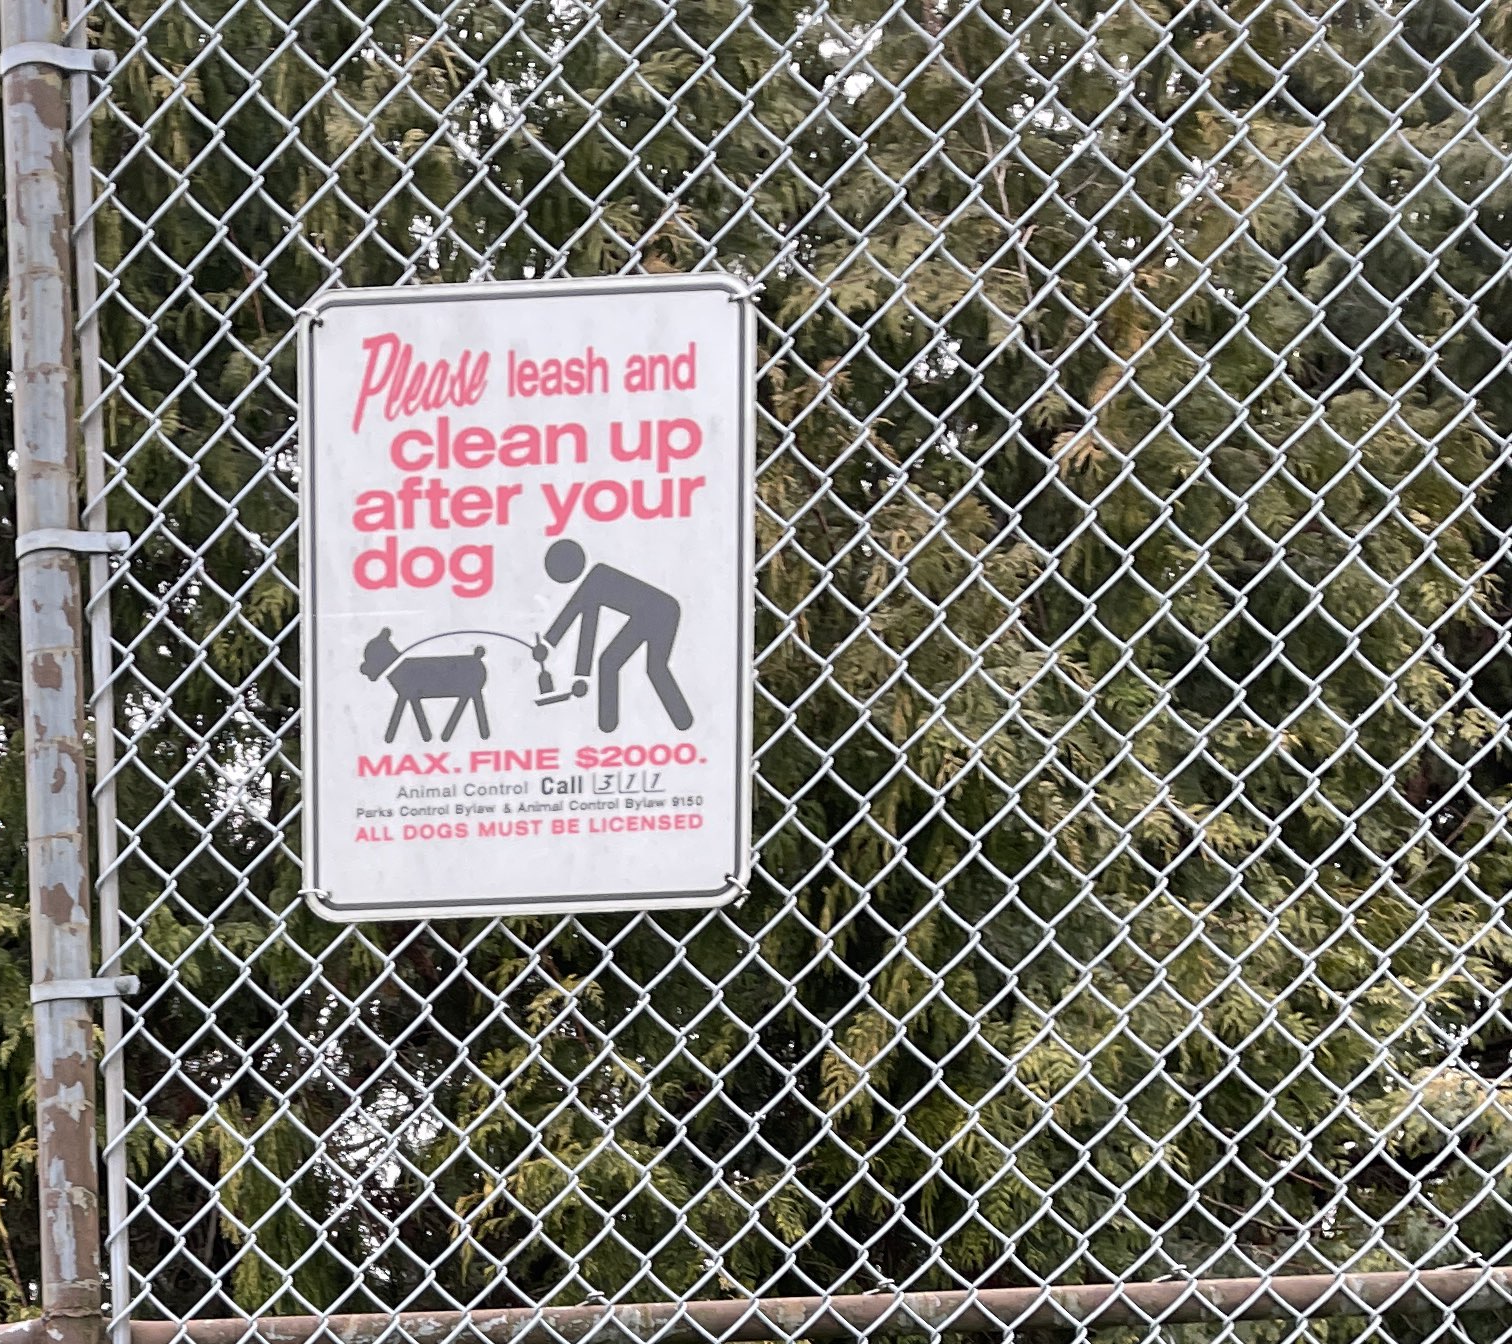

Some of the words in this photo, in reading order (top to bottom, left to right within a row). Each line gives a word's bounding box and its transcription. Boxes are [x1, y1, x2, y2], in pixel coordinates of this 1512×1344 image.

[352, 332, 490, 433] Please
[508, 347, 608, 397] leash
[625, 342, 696, 391] and
[390, 416, 587, 471] clean
[611, 418, 703, 473] up
[352, 477, 522, 532] after
[542, 476, 705, 536] your
[353, 536, 494, 598] dog
[357, 752, 462, 777] MAX.
[470, 748, 560, 773] FINE
[575, 743, 707, 769] $2000.
[356, 806, 393, 818] Parks
[400, 804, 449, 817] Control
[456, 803, 496, 816] Bylaw
[504, 803, 512, 814] &
[518, 801, 563, 812] Animal
[569, 798, 618, 811] Control
[625, 797, 665, 811] Bylaw
[396, 784, 456, 799] Animal
[464, 781, 528, 797] Control
[541, 776, 583, 795] Call
[355, 825, 393, 842] ALL
[403, 822, 469, 840] DOGS
[478, 819, 543, 837] MUST
[551, 818, 579, 834] BE
[589, 813, 704, 833] LICENSED
